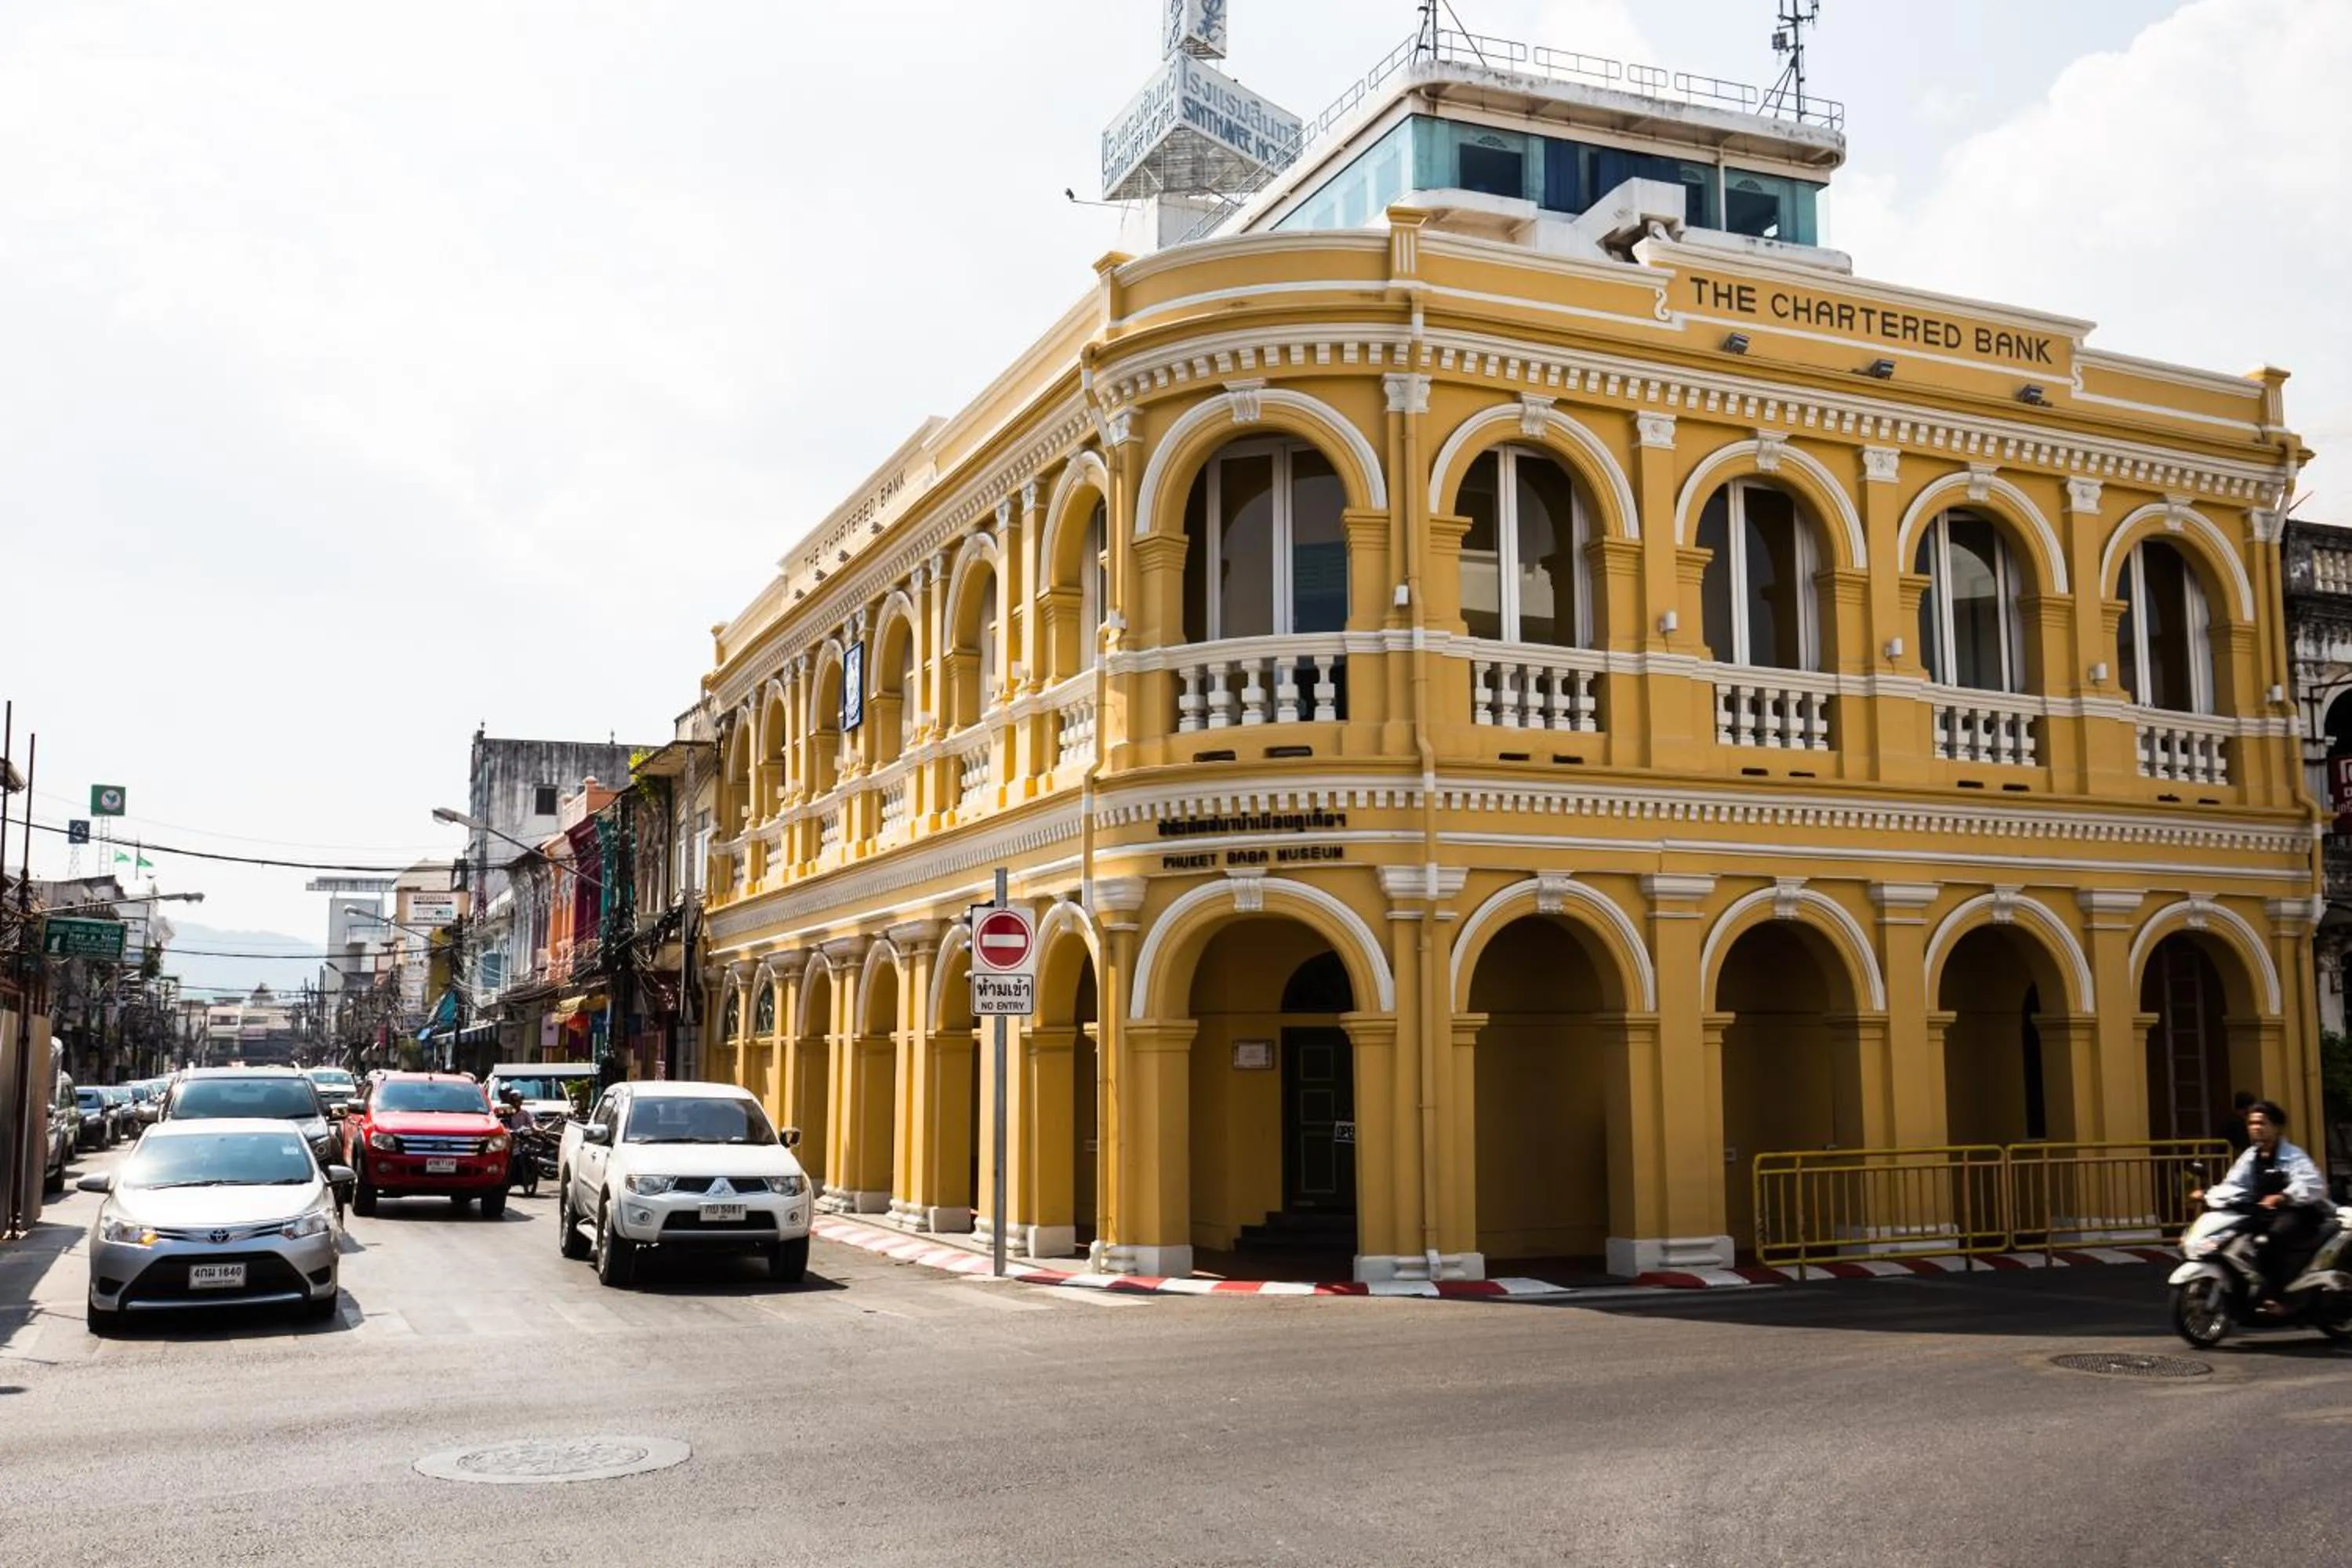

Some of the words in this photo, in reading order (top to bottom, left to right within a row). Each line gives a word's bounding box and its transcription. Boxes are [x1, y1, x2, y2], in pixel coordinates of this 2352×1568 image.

[1690, 277, 1756, 313] THE
[1770, 292, 1962, 349] CHARTERED
[1974, 327, 2053, 365] BANK
[824, 497, 876, 556] CHARTERED
[880, 469, 906, 509] BANK
[1163, 853, 1218, 869] PHUKET
[1227, 850, 1269, 865] BABA
[1276, 846, 1344, 862] MUSEUM
[977, 978, 1030, 996] ห้ามเข้า
[981, 1001, 993, 1010] NO
[996, 1001, 1025, 1010] ENTRY
